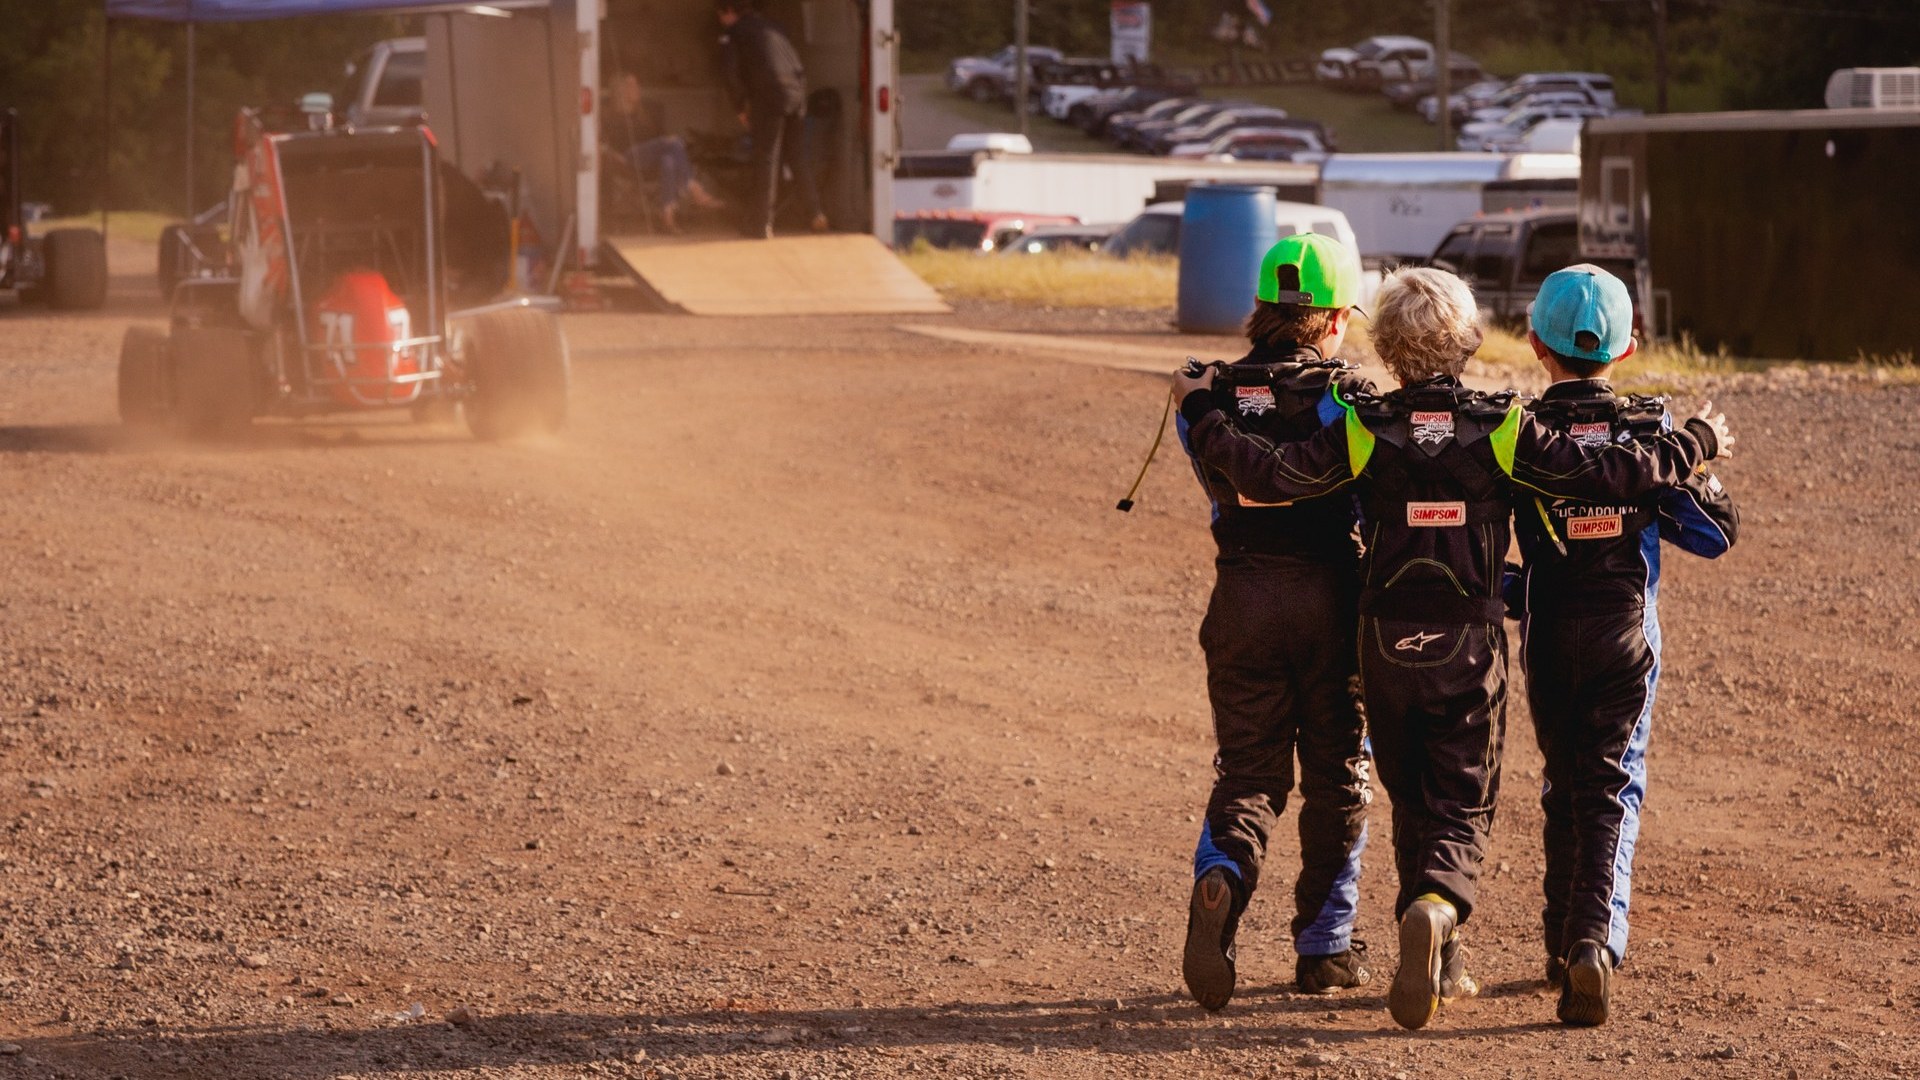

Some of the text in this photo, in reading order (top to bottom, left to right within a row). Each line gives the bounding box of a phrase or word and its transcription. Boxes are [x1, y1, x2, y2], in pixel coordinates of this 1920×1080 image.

[1238, 388, 1270, 396] SIMPSON
[1414, 413, 1450, 422] SIMPSON
[1572, 424, 1608, 434] SIMPSON
[1412, 509, 1459, 520] SIMPSON
[1573, 520, 1617, 534] SIMPSON
